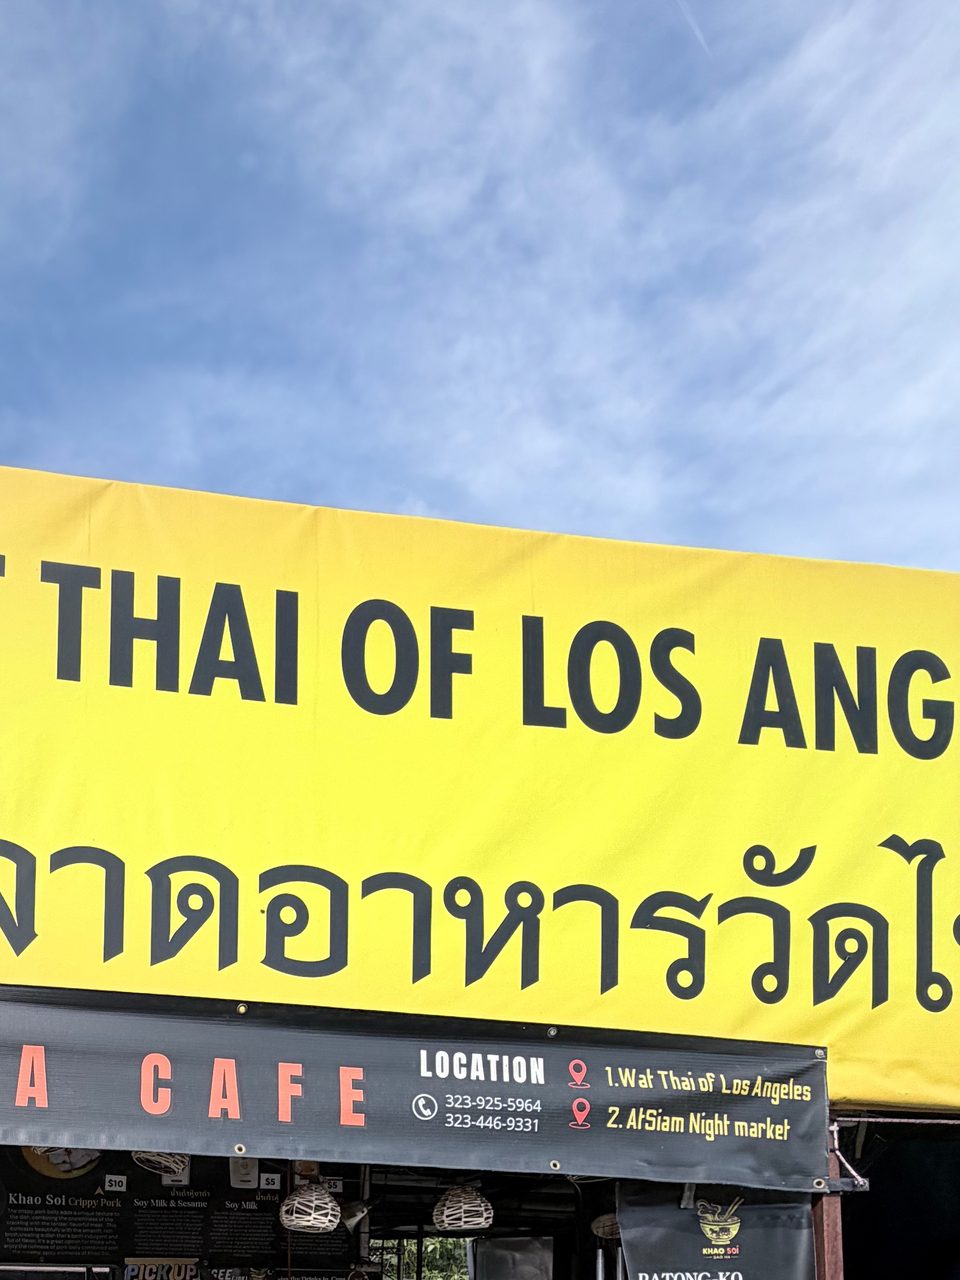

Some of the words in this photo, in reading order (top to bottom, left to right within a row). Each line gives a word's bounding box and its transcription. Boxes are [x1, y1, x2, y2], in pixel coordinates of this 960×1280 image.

[41, 560, 299, 705] THAI
[341, 598, 474, 719] OF
[521, 614, 703, 740] LOS
[419, 1049, 545, 1085] LOCATION
[140, 1052, 365, 1127] CAFE
[657, 1069, 696, 1092] Thai
[700, 1073, 714, 1093] of
[721, 1074, 750, 1097] Los
[752, 1076, 812, 1106] Angeles
[445, 1094, 542, 1113] 323-925-5964
[445, 1114, 539, 1133] 323-446-9331
[607, 1107, 622, 1129] 2.
[690, 1112, 730, 1140] Night
[734, 1117, 791, 1140] market
[108, 1179, 123, 1188] $10
[265, 1178, 275, 1186] $5
[8, 1193, 42, 1206] Khao
[46, 1195, 66, 1207] Soi
[68, 1198, 98, 1209] Crippy
[100, 1198, 122, 1208] Pork
[133, 1199, 148, 1209] Soy
[150, 1200, 168, 1209] Milk
[178, 1200, 208, 1209] Sesame
[225, 1200, 240, 1211] Soy
[702, 1247, 725, 1255] KHAO
